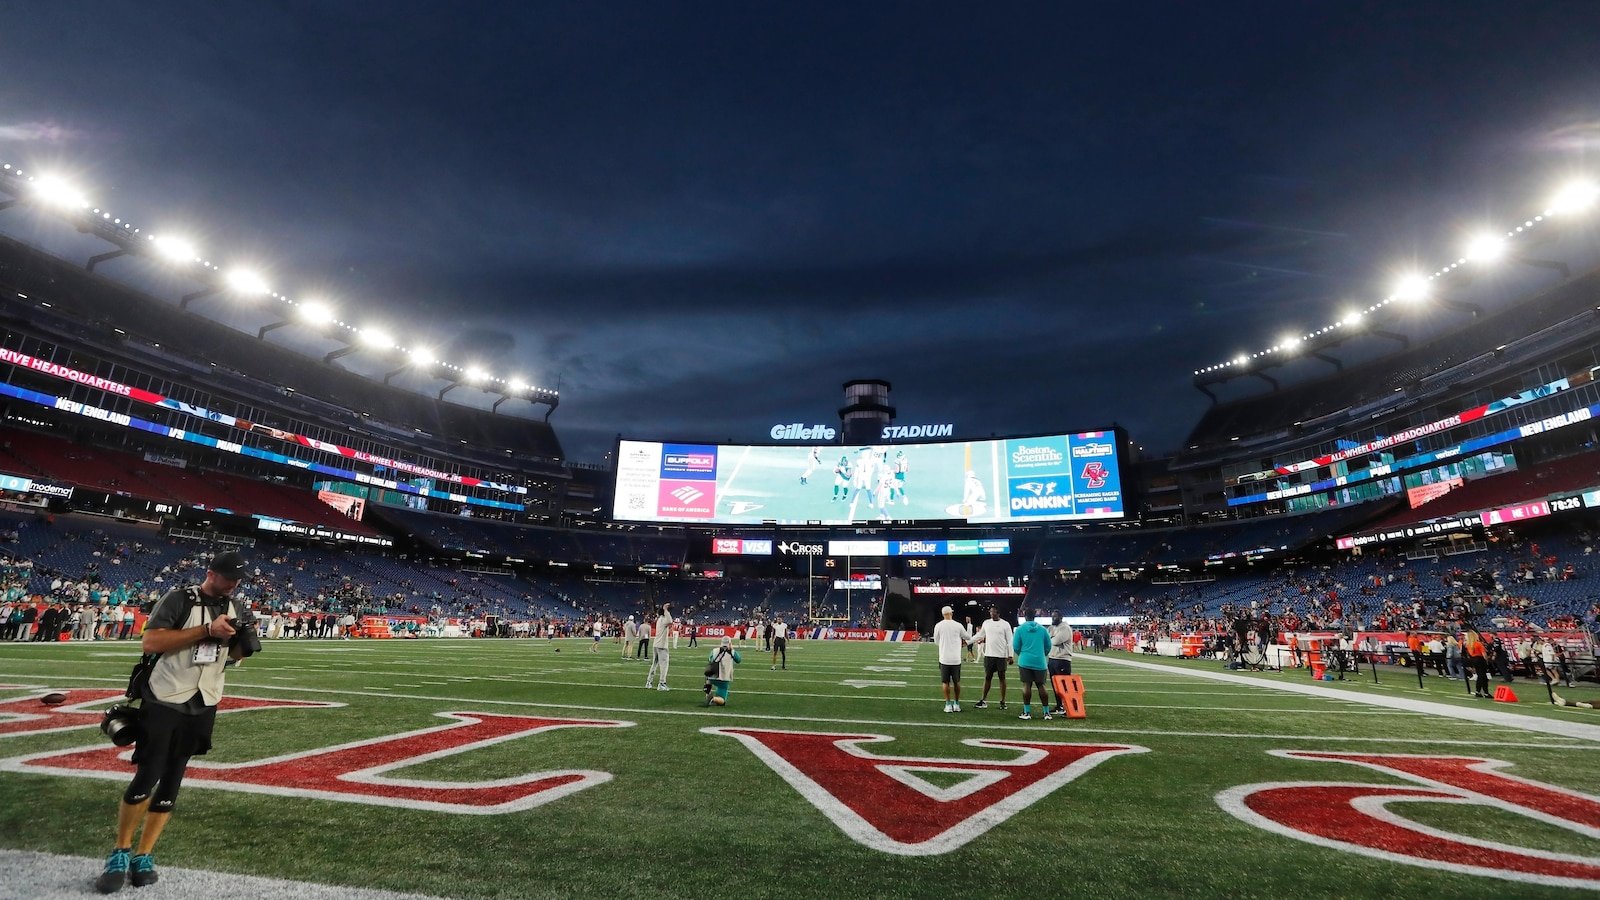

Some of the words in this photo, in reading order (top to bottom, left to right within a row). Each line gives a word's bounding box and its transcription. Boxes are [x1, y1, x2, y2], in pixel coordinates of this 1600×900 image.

[31, 360, 131, 396] HEADQUARTERS
[55, 398, 84, 414] NEW
[82, 405, 131, 426] ENGLAND
[169, 427, 184, 440] VS
[216, 440, 242, 454] MIAMI
[1520, 423, 1544, 437] NEW
[1544, 407, 1591, 430] ENGLAND
[770, 424, 836, 440] Gillette
[881, 423, 953, 439] STADIUM
[1331, 444, 1371, 462] ALL-WHEEL
[1371, 437, 1394, 450] DRIVE
[1394, 415, 1461, 444] HEADQUARTERS
[1012, 449, 1062, 463] Scientific
[1018, 446, 1049, 455] Boston
[1435, 448, 1460, 460] verizon
[666, 456, 710, 465] SUFFOLK
[353, 451, 392, 465] ALL-WHEEL
[392, 461, 412, 472] DRIVE
[413, 466, 462, 483] HEADQUARERS
[355, 472, 371, 483] NEW
[370, 476, 397, 489] ENGLAND
[30, 483, 71, 496] moderna
[1267, 490, 1282, 500] NEW
[1282, 484, 1312, 498] ENGLAND
[1336, 476, 1347, 486] VS
[156, 504, 167, 513] QTR
[1551, 497, 1580, 511] 78:26
[1512, 508, 1524, 519] NE
[1532, 506, 1540, 514] 0
[281, 524, 297, 532] 0:00
[1434, 524, 1441, 532] 0
[1464, 518, 1471, 526] 0
[1380, 533, 1385, 541] 0
[744, 541, 770, 553] VISA
[899, 541, 937, 555] jetBlue
[826, 559, 835, 567] 25
[908, 559, 927, 567] 78:26
[705, 628, 725, 636] 1960
[1496, 687, 1506, 699] 10
